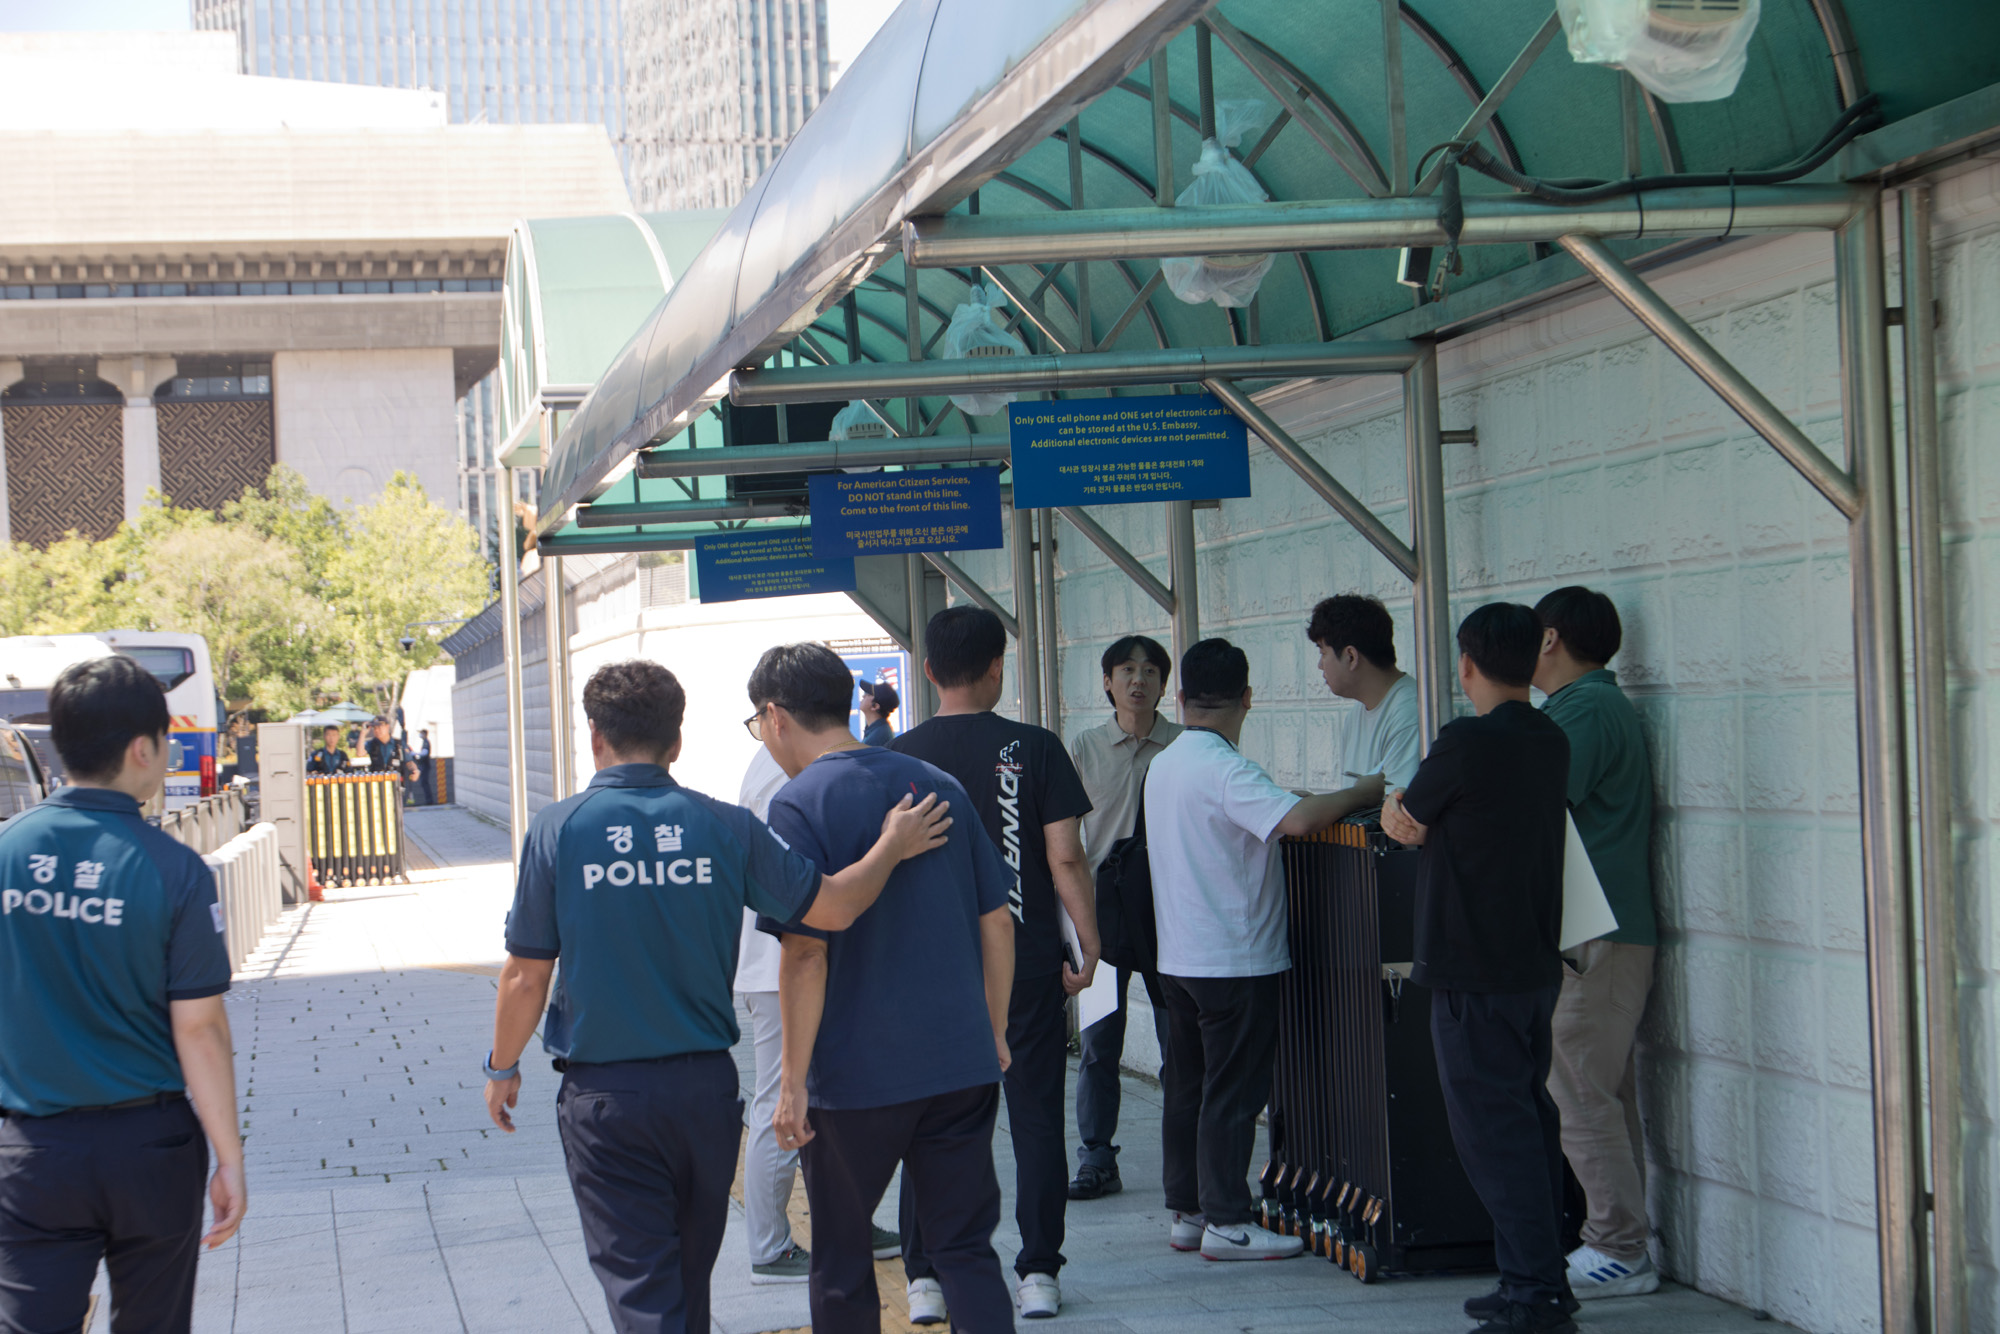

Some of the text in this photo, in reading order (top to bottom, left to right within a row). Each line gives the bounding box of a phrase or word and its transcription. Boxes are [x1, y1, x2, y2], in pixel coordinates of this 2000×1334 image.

[1015, 416, 1034, 425] Only
[1036, 415, 1055, 424] ONE
[1057, 414, 1072, 423] cell
[1074, 414, 1100, 423] phone
[1103, 412, 1118, 420] and
[1120, 411, 1138, 420] ONE
[1141, 411, 1153, 419] set
[1155, 409, 1164, 418] of
[1166, 408, 1207, 417] electronic
[1208, 408, 1221, 416] car
[1076, 426, 1086, 434] be
[1088, 424, 1115, 433] stored
[1117, 424, 1125, 432] at
[1127, 423, 1141, 431] the
[1143, 422, 1160, 431] U.S.
[1162, 421, 1200, 430] Embassy.
[1031, 438, 1076, 448] Additional
[1078, 436, 1119, 446] electronic
[1122, 435, 1152, 444] devices
[1185, 430, 1229, 441] permitted.
[1081, 464, 1100, 472] 입장시
[1138, 462, 1157, 470] 물품은
[1159, 460, 1185, 468] 휴대전화
[1187, 459, 1204, 467] 1개와
[838, 476, 970, 490] For American Citizen Services,
[1150, 472, 1172, 480] 입니다.
[1084, 486, 1096, 494] 기타
[1113, 484, 1132, 493] 물품은
[1134, 483, 1154, 491] 반입이
[1155, 482, 1184, 490] 안됩니다.
[848, 489, 961, 502] DO NOT stand in this line.
[841, 507, 866, 515] Come
[880, 505, 895, 513] the
[897, 504, 920, 512] front
[922, 502, 931, 511] of
[933, 502, 949, 511] this
[952, 501, 970, 510] line.
[846, 525, 968, 539] 미국시민업무를 위해 오신 분은 이곳에
[858, 535, 958, 548] 줄서지 마시고 앞으로 오십시오.
[583, 857, 712, 890] POLICE
[2, 889, 125, 926] POLICE
